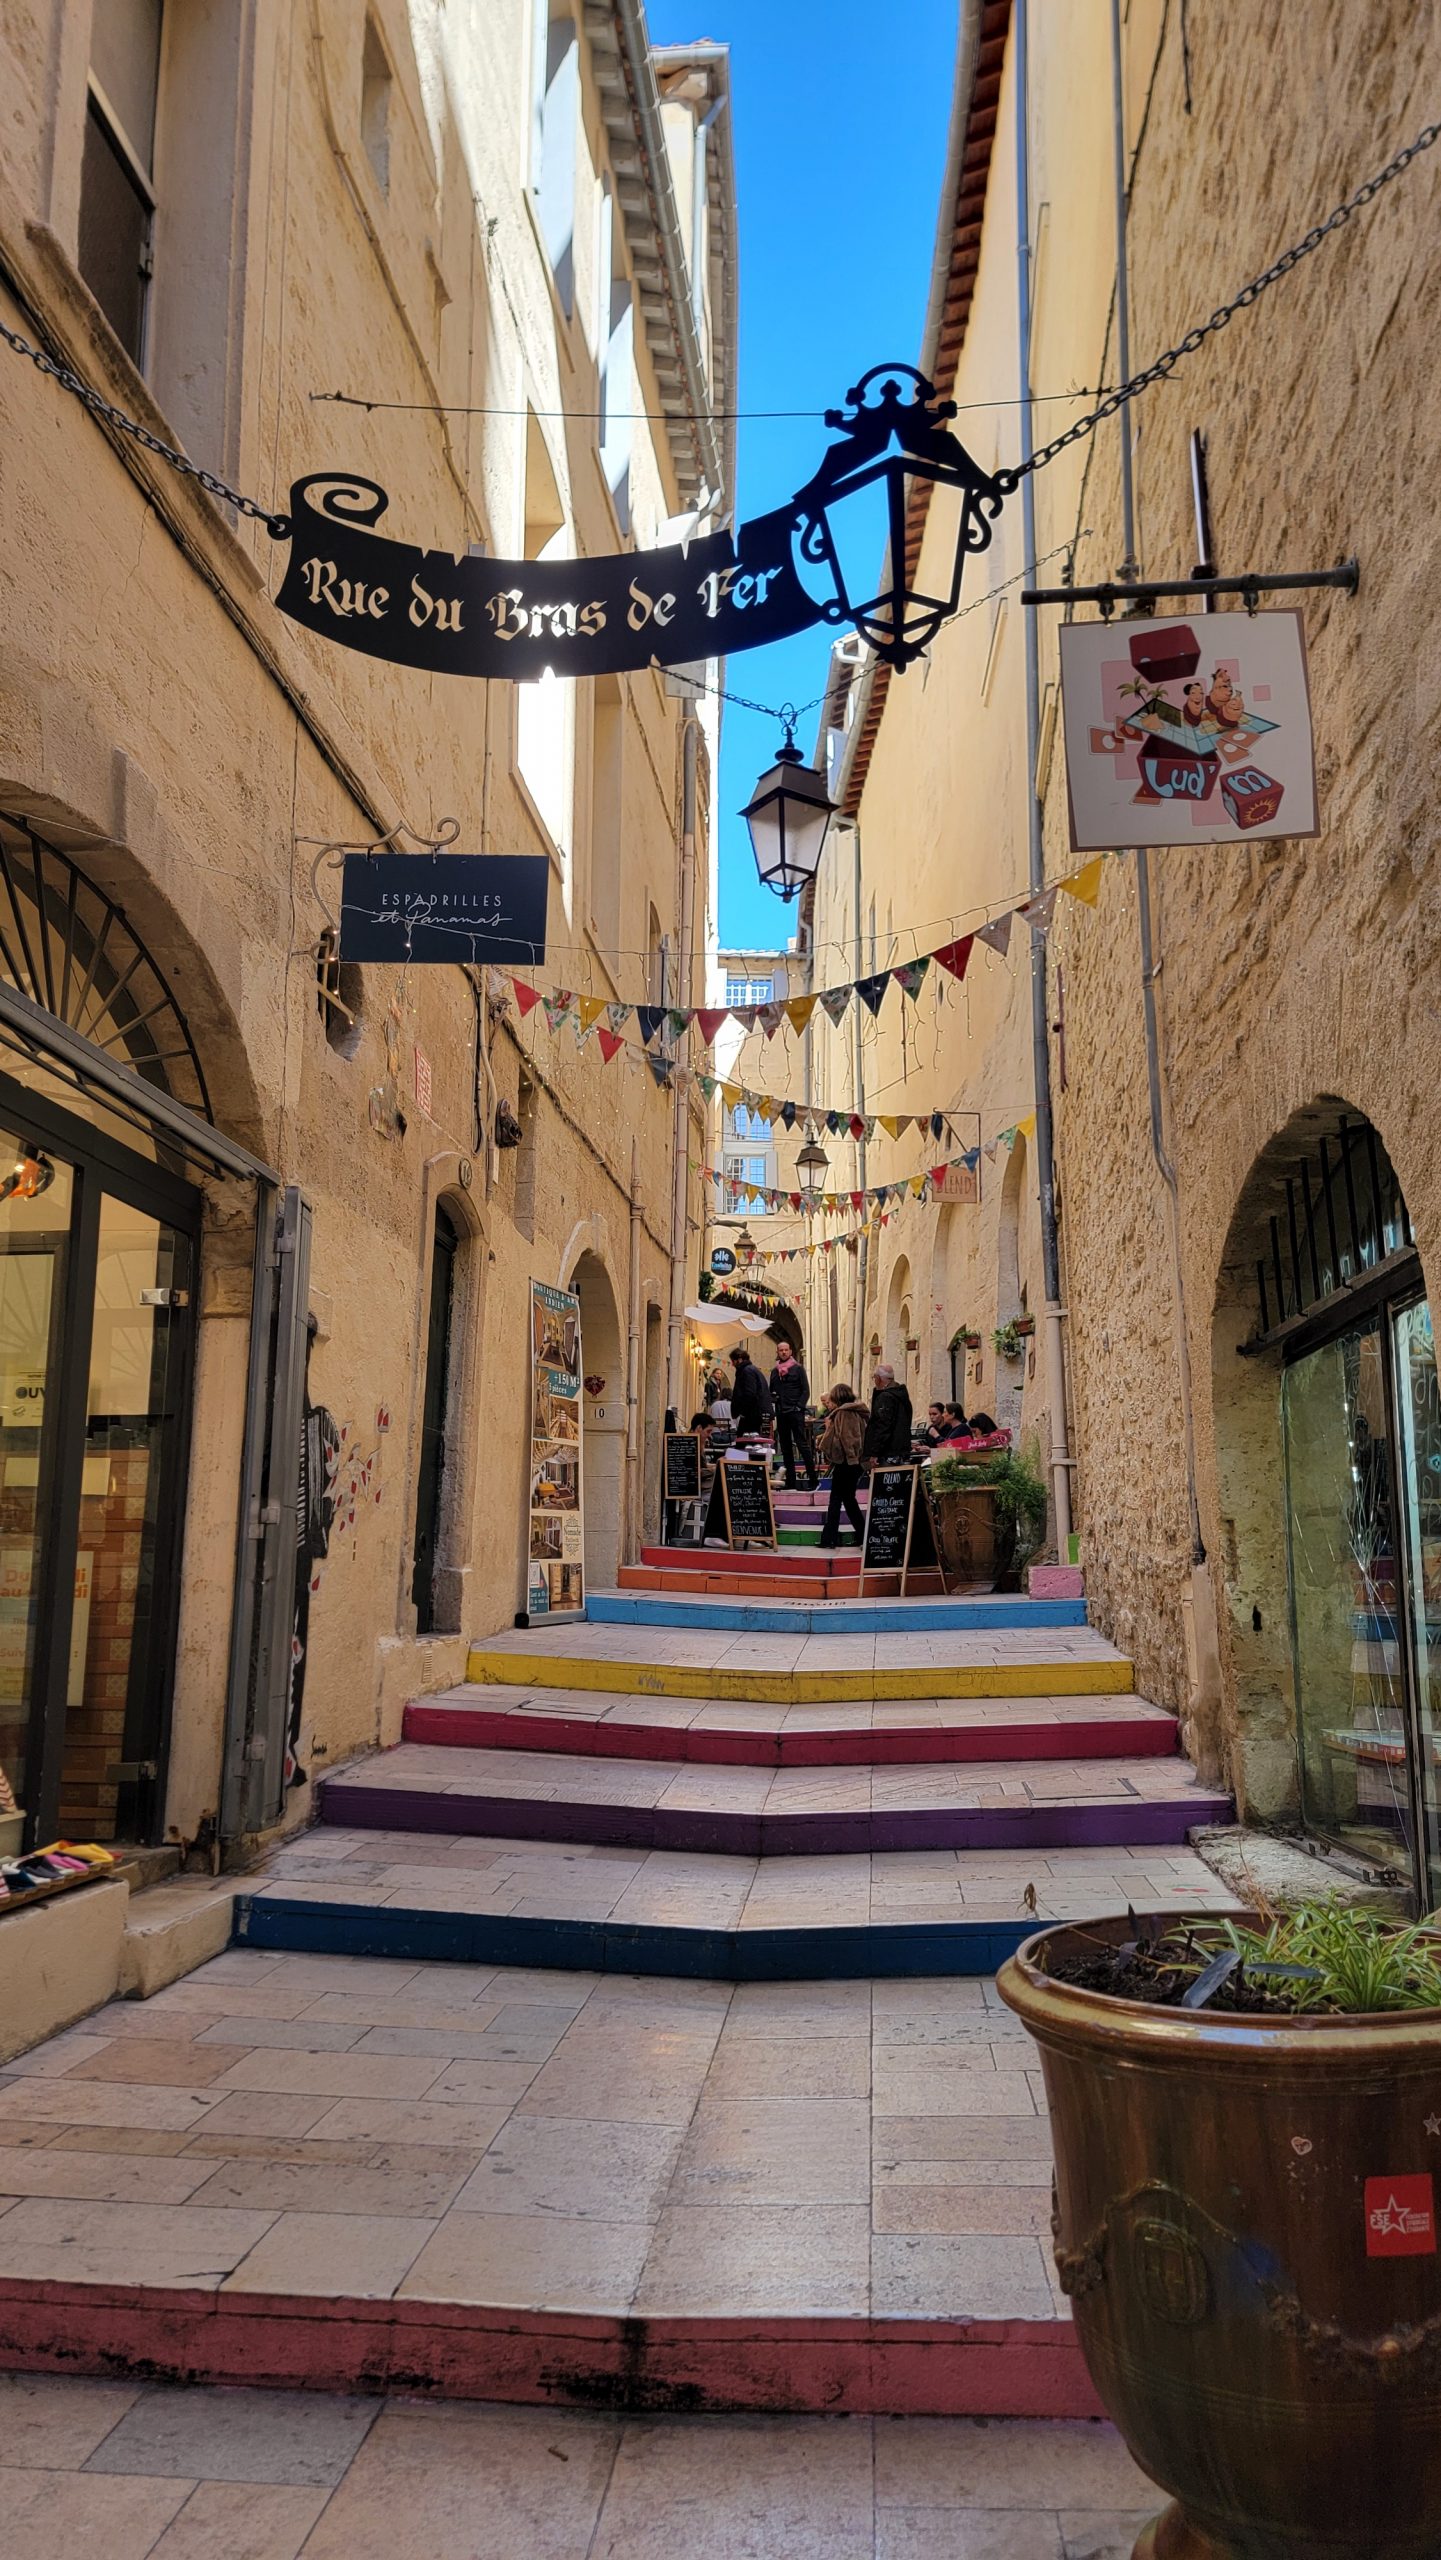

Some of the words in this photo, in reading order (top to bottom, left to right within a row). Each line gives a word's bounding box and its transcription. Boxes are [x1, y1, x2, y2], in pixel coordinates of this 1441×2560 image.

[301, 557, 390, 620] Rue
[408, 573, 466, 632] du
[484, 589, 607, 641] Bras
[627, 577, 676, 631] de
[697, 564, 784, 618] Fer
[382, 893, 502, 907] ESPADRILLES
[371, 910, 400, 924] et
[405, 901, 513, 927] Panamas
[545, 1297, 565, 1310] INDIEN
